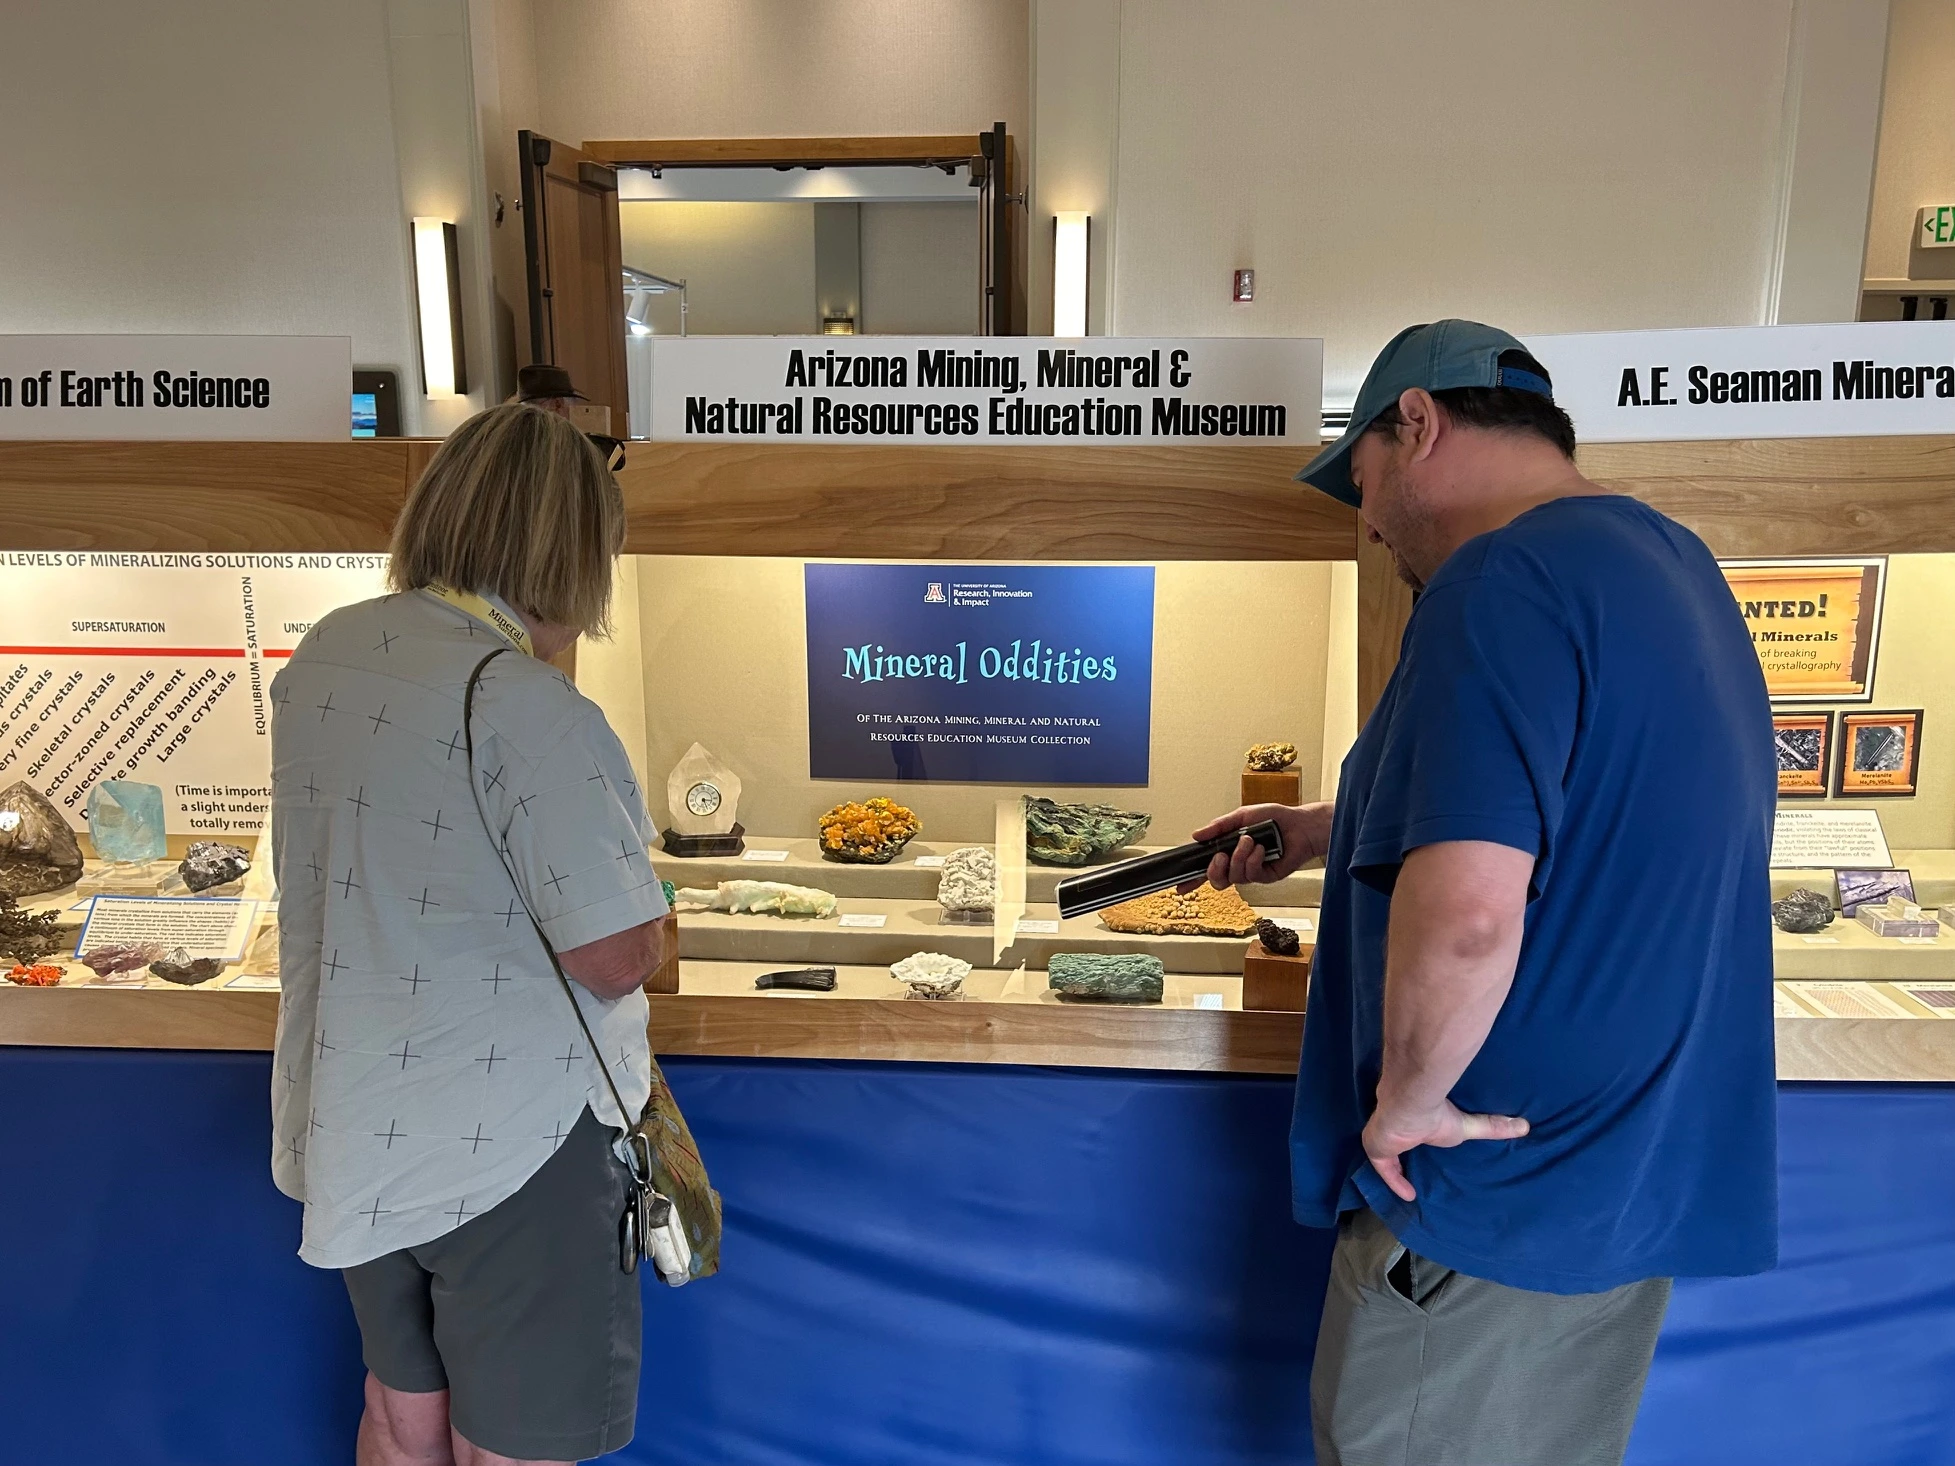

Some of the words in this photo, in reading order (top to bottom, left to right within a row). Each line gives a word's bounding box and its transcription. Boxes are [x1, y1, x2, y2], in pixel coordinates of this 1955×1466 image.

[21, 370, 52, 407] of
[60, 370, 144, 407] Earth
[153, 370, 270, 408] Science
[785, 350, 907, 387] Arizona
[917, 350, 1027, 394] Mining,
[1037, 350, 1160, 388] Mineral
[1169, 350, 1192, 388] &
[1617, 367, 1677, 406] A.E.
[1688, 365, 1822, 405] Seaman
[1832, 361, 1955, 400] Minera
[685, 397, 803, 434] Natural
[812, 397, 979, 435] Resources
[988, 398, 1142, 436] Education
[1151, 398, 1286, 436] Museum
[9, 553, 62, 566] LEVELS
[66, 554, 86, 566] OF
[91, 554, 202, 568] MINERALIZING
[206, 556, 294, 568] SOLUTIONS
[298, 556, 332, 568] AND
[242, 576, 258, 649] SATURATION
[954, 590, 990, 598] Research,
[962, 598, 989, 607] Impact
[1737, 594, 1827, 618] NTED!
[72, 621, 166, 633] SUPERSATURATION
[488, 608, 524, 640] Mineral
[1761, 631, 1838, 642] Minerals
[252, 651, 257, 659] =
[842, 642, 968, 684] Mineral
[980, 640, 1117, 684] Oddities
[1760, 649, 1771, 658] of
[1774, 649, 1816, 659] breaking
[1768, 661, 1841, 671] crystallography
[10, 669, 53, 720] crystals
[15, 722, 40, 749] fine
[40, 670, 83, 722] crystals
[250, 661, 266, 736] EQUILIBRIUM
[27, 724, 72, 778] Skeletal
[72, 672, 116, 724] crystals
[44, 721, 110, 798] ector-zoned
[110, 669, 155, 722] crystals
[126, 722, 168, 770] growth
[166, 668, 216, 722] banding
[156, 724, 192, 763] Large
[192, 670, 236, 724] crystals
[64, 750, 116, 808] Selective
[114, 668, 186, 750] replacement
[176, 784, 210, 796] (Time
[213, 786, 222, 796] is
[181, 804, 188, 812] a
[191, 801, 226, 814] slight
[190, 818, 230, 830] totally
